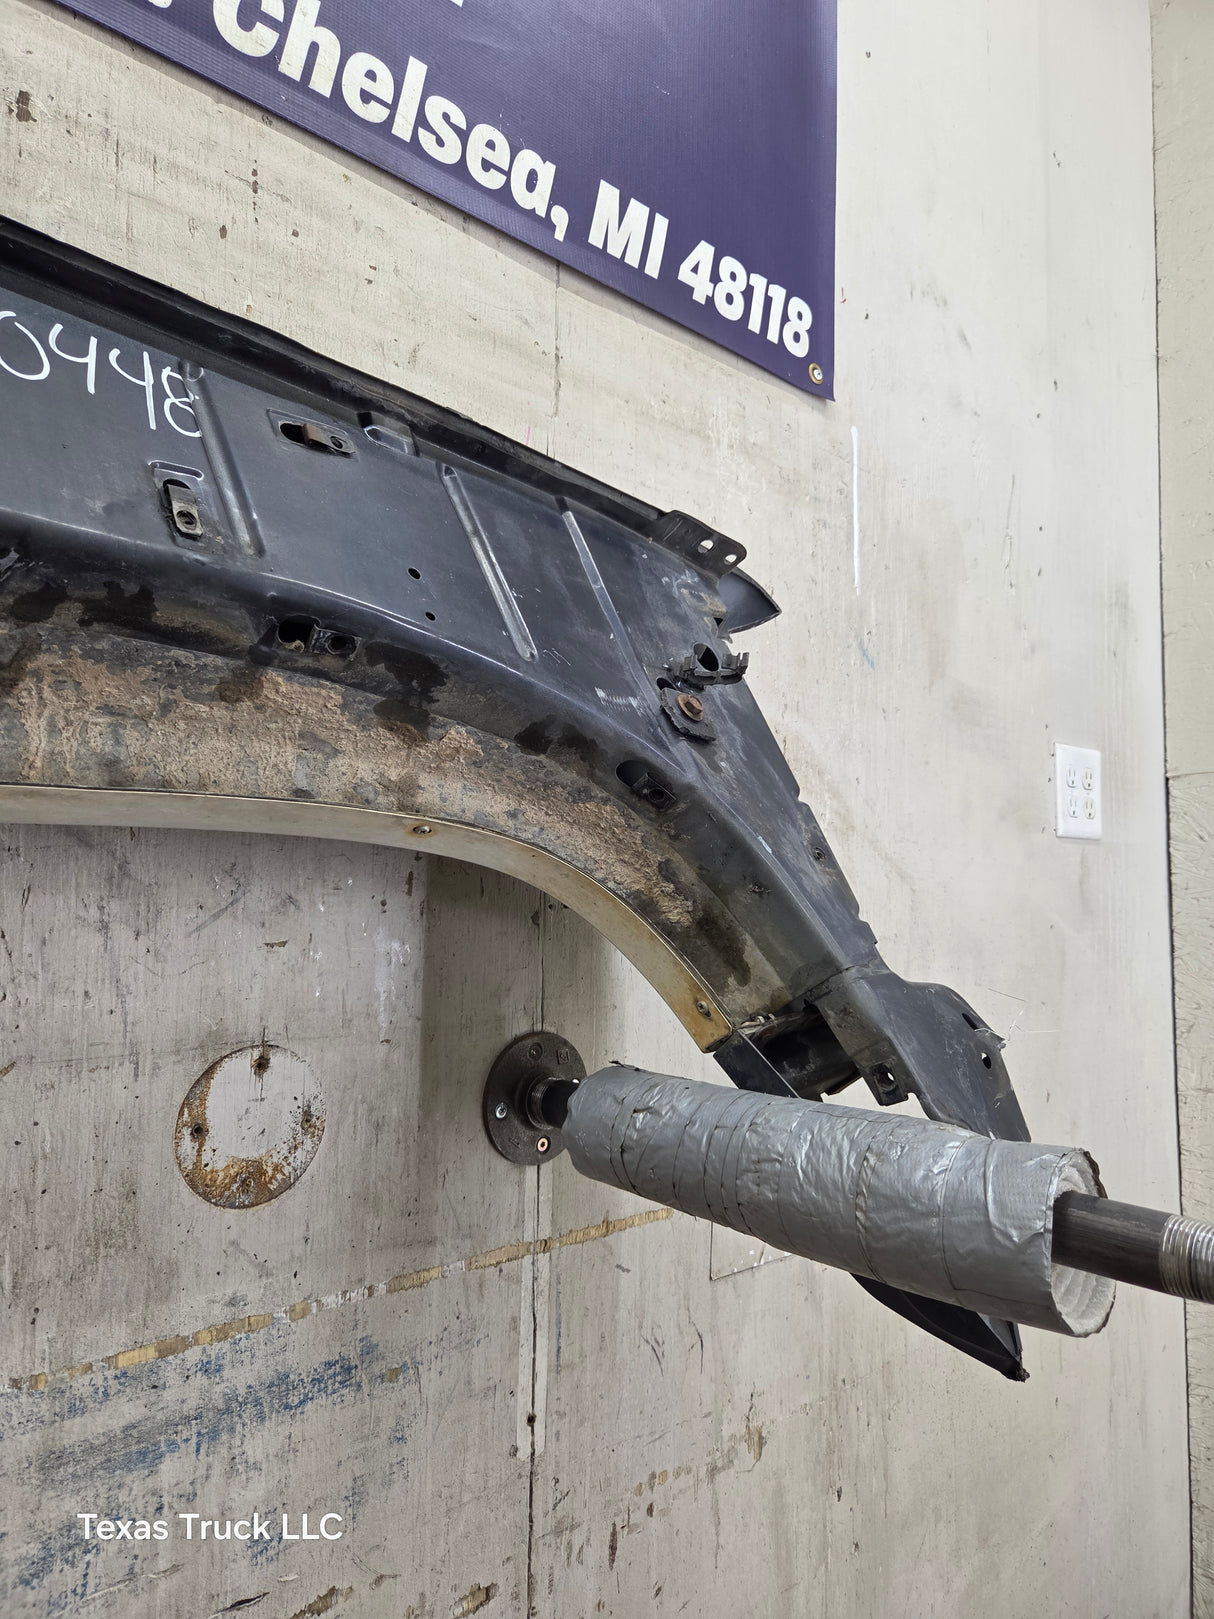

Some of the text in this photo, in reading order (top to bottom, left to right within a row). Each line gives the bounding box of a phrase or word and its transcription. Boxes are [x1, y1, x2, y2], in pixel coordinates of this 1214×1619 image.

[213, 0, 812, 358] Chelsea, MI 48118
